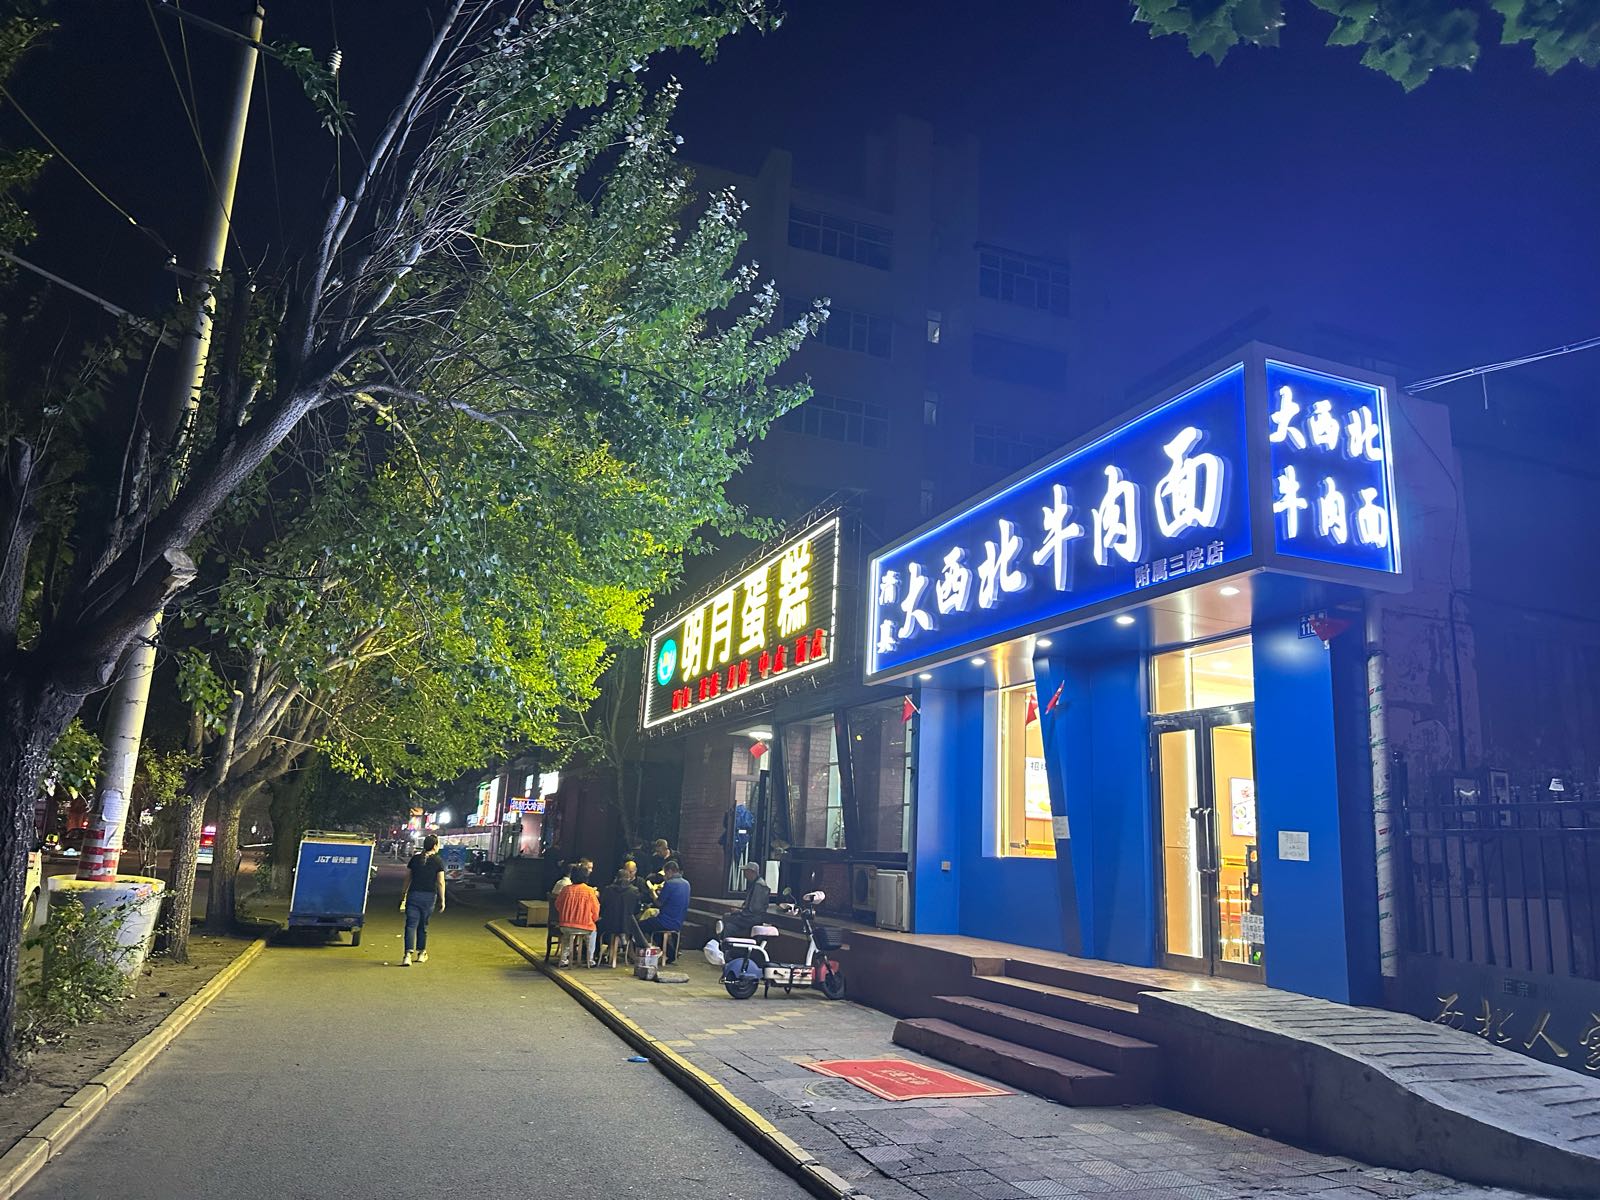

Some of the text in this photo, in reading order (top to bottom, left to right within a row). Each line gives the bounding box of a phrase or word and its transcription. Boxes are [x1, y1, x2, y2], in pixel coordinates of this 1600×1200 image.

[1269, 385, 1384, 461] 大西北
[897, 426, 1225, 638] 大西北牛肉面
[1273, 464, 1388, 548] 牛肉面
[1134, 540, 1224, 588] 附属三院店
[681, 539, 813, 682] 明月蛋糕
[314, 855, 332, 864] J&T
